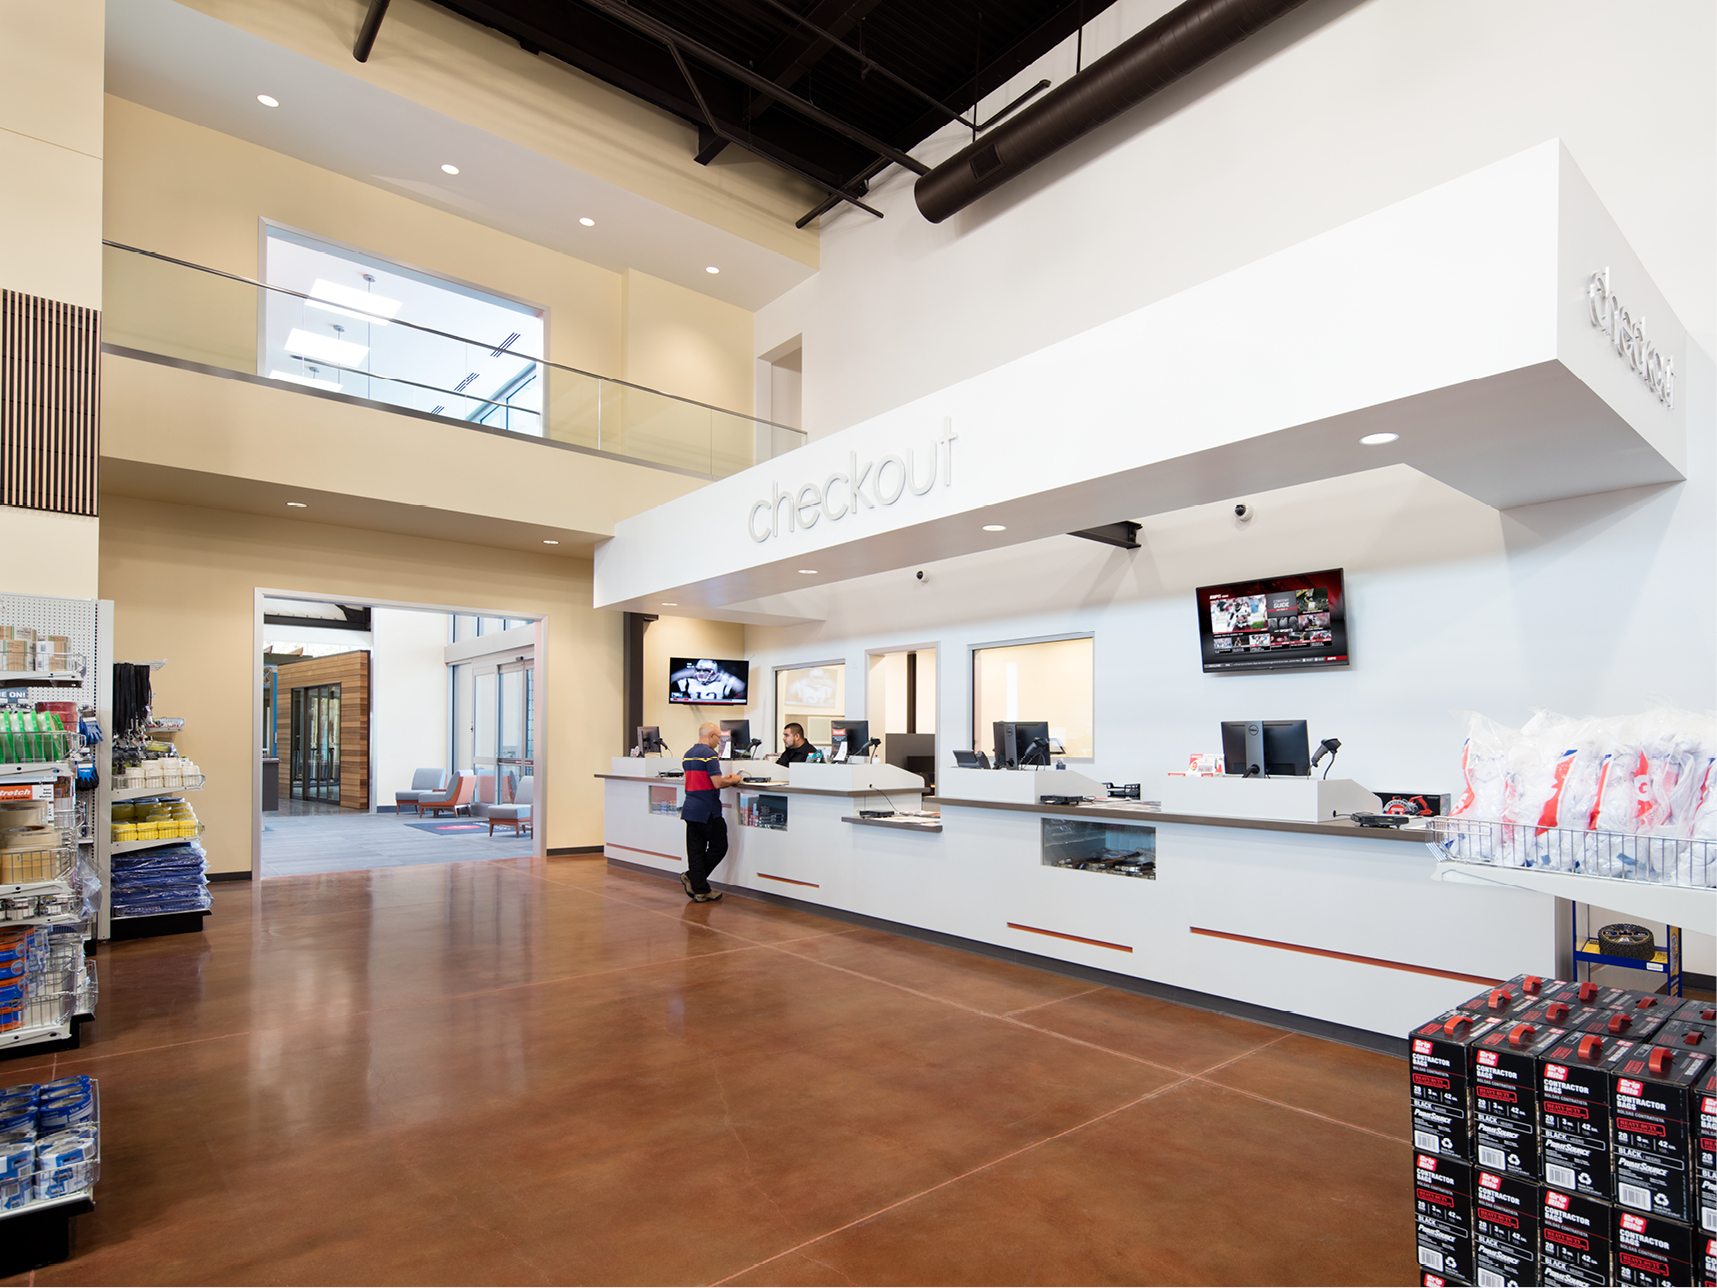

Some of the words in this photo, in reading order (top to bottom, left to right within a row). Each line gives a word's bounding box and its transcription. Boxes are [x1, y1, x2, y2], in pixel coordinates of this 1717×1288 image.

[1588, 266, 1676, 411] checkout
[748, 415, 958, 543] checkout
[1412, 1053, 1451, 1067] CONTRACTOR
[1480, 1050, 1497, 1060] Grip
[1413, 1058, 1428, 1067] BAGS
[1476, 1064, 1518, 1079] CONTRACTOR
[1476, 1070, 1493, 1080] BAGS
[1548, 1065, 1566, 1074] Grip
[1547, 1071, 1564, 1080] Rite
[1544, 1079, 1590, 1094] CONTRACTOR
[1544, 1085, 1562, 1094] BAGS
[1621, 1079, 1641, 1090] Grip
[1620, 1086, 1639, 1096] Rite
[1414, 1099, 1432, 1110] BLACK
[1616, 1094, 1667, 1111] CONTRACTOR
[1617, 1101, 1637, 1111] BAGS
[1478, 1114, 1498, 1124] BLACK
[1701, 1121, 1716, 1129] BAG
[1546, 1130, 1567, 1140] BLACK
[1658, 1140, 1668, 1148] 42
[1618, 1147, 1642, 1159] BLACK
[1702, 1152, 1713, 1160] 20
[1416, 1168, 1455, 1185] CONTRACTOR
[1417, 1174, 1432, 1184] BAGS
[1478, 1186, 1520, 1205] CONTRACTOR
[1478, 1192, 1495, 1203] BAGS
[1549, 1192, 1568, 1203] Grip
[1418, 1215, 1436, 1226] BLACK
[1544, 1206, 1591, 1226] CONTRACTOR
[1545, 1212, 1563, 1224] BAGS
[1624, 1214, 1644, 1225] Grip
[1623, 1221, 1642, 1232] Rite
[1478, 1235, 1498, 1247] BLACK
[1619, 1229, 1670, 1250] CONTRACTOR
[1620, 1236, 1640, 1247] BAGS
[1545, 1257, 1567, 1270] BLACK
[1582, 1254, 1591, 1262] 42
[1621, 1266, 1631, 1275] 20
